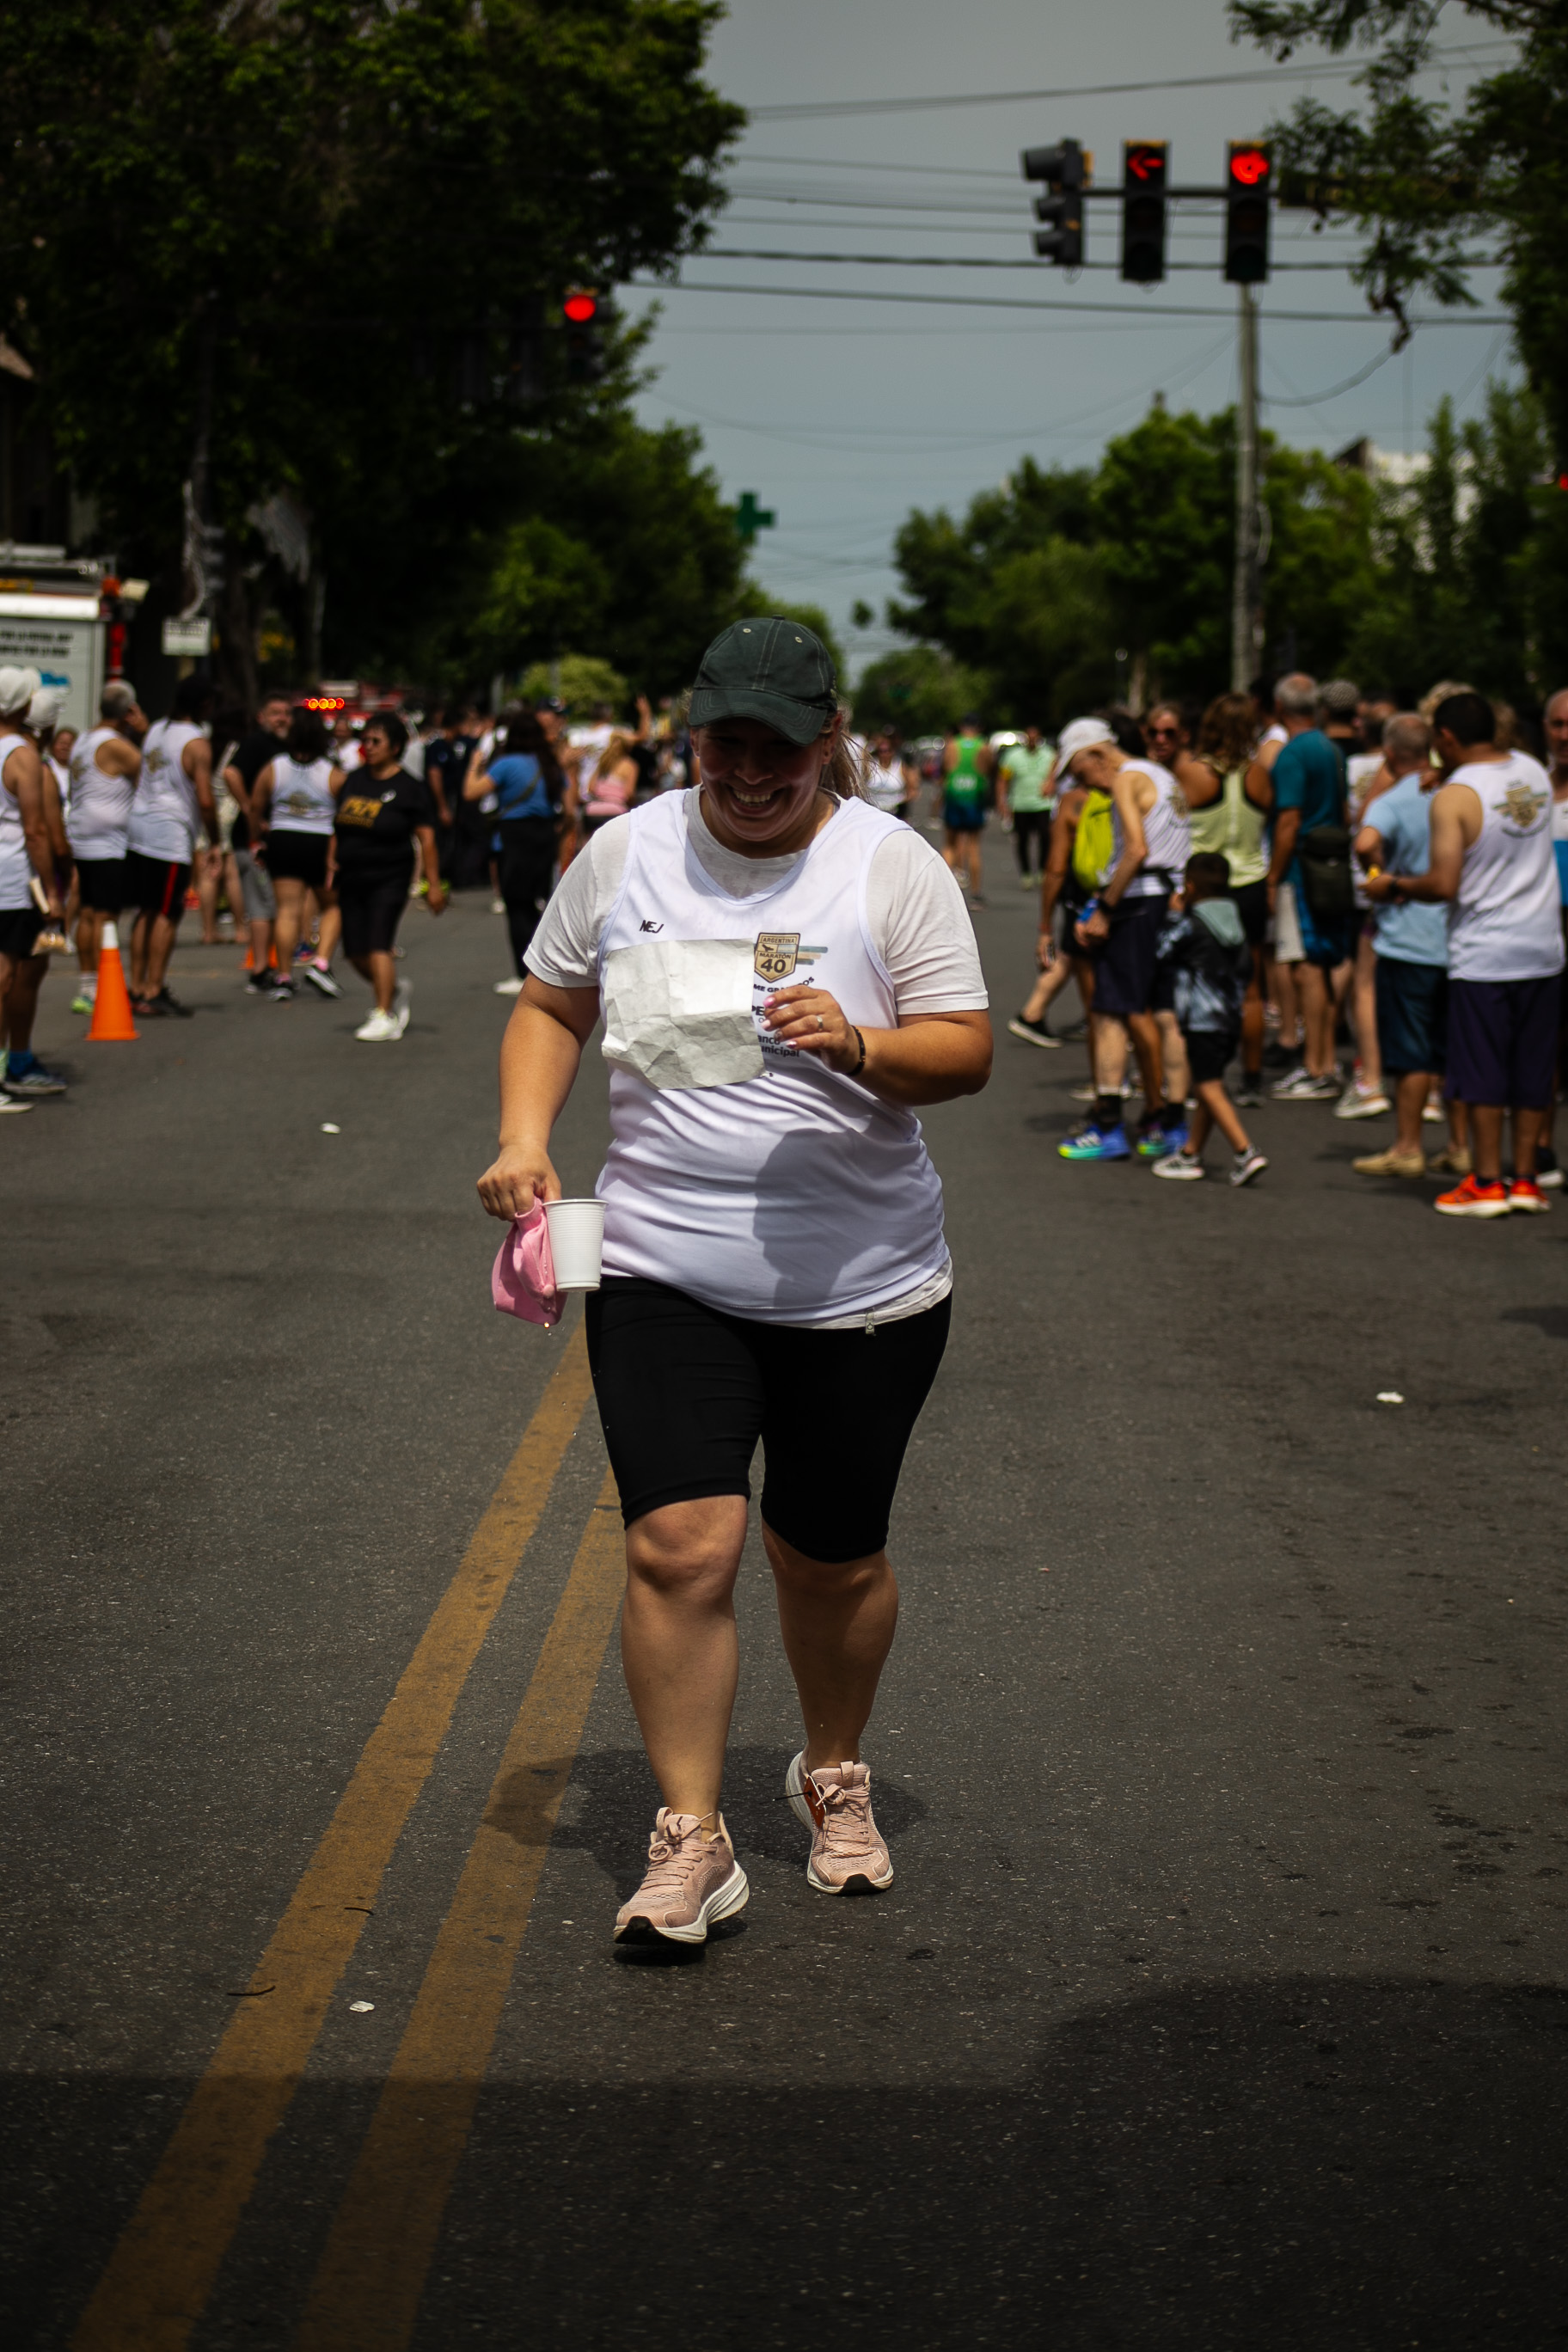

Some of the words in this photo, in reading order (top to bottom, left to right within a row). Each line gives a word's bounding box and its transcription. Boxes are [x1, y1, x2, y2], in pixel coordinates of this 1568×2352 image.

[760, 959, 787, 974] 40
[753, 983, 766, 992] ME
[757, 1034, 781, 1045] anco
